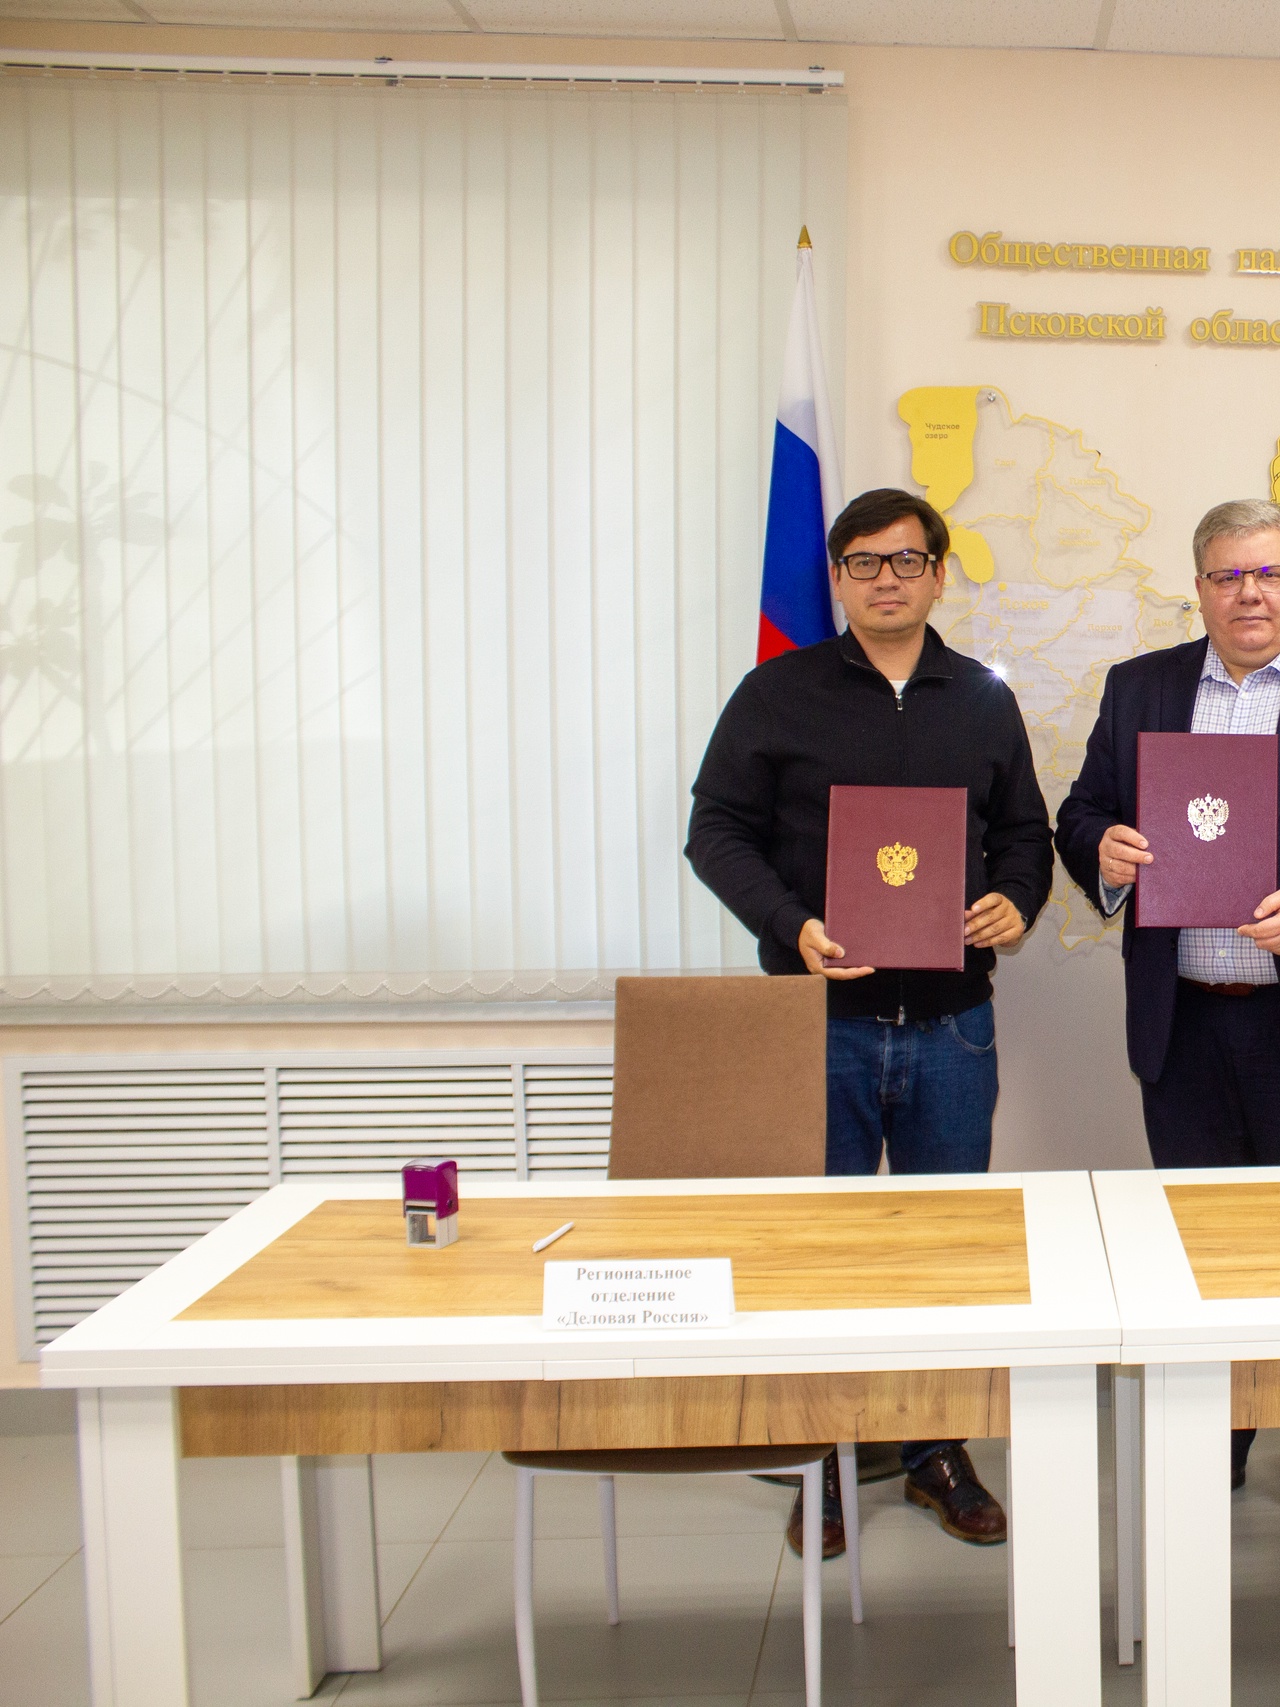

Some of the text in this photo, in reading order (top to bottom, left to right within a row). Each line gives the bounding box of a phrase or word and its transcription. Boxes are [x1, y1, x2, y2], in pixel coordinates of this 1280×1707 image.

[949, 231, 1210, 271] Общественная
[976, 302, 1166, 339] Псковской
[925, 422, 960, 430] Чудское
[999, 598, 1049, 610] Псков
[1087, 623, 1122, 632] Порхов
[1154, 619, 1173, 627] Дно
[576, 1267, 692, 1281] Региональное
[591, 1291, 676, 1303] отделение
[557, 1310, 709, 1327] «Деловая Россия»
